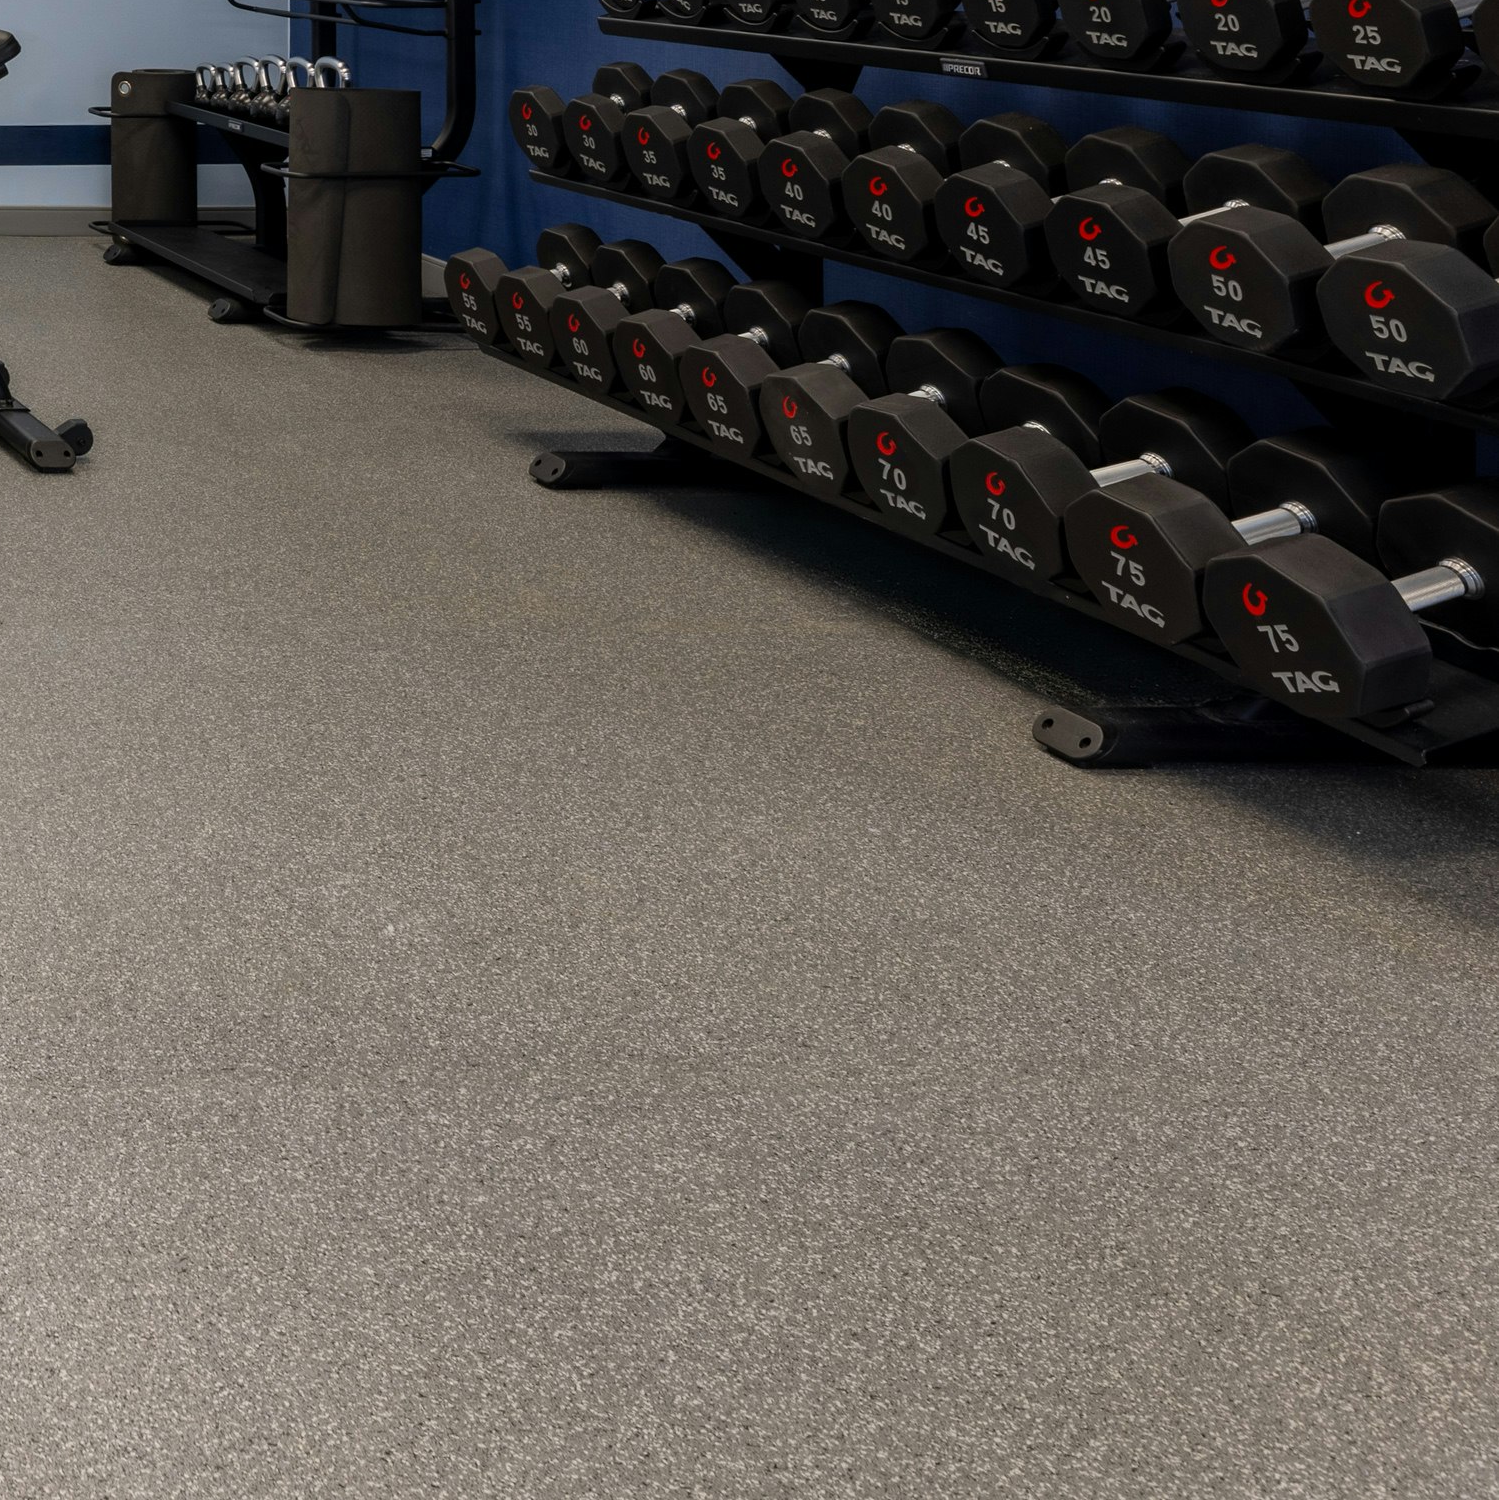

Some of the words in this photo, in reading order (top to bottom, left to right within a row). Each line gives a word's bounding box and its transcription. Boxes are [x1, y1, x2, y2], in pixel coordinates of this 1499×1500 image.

[739, 4, 762, 13] TAG
[811, 8, 837, 21] TAG
[1090, 6, 1111, 22] 20
[890, 13, 922, 26] TAG
[985, 21, 1021, 35] TAG
[1215, 14, 1239, 31] 20
[1086, 31, 1127, 47] TAG
[1353, 25, 1381, 44] 25
[1210, 41, 1257, 57] TAG
[947, 63, 982, 77] PRECOR
[1347, 55, 1401, 73] TAG
[527, 124, 537, 136] 30
[527, 145, 549, 158] TAG
[583, 135, 595, 149] 30
[580, 154, 605, 172] TAG
[643, 151, 656, 163] 35
[643, 173, 670, 187] TAG
[711, 165, 725, 180] 35
[709, 186, 738, 206] TAG
[785, 182, 803, 200] 40
[781, 205, 815, 227] TAG
[872, 201, 892, 220] 40
[866, 224, 905, 249] TAG
[967, 222, 989, 244] 45
[960, 246, 1003, 275] TAG
[1084, 247, 1110, 269] 45
[1078, 276, 1129, 302] TAG
[1212, 275, 1242, 301] 50
[463, 293, 477, 310] 55
[463, 314, 487, 334] TAG
[516, 314, 531, 331] 55
[1204, 306, 1262, 338] TAG
[1370, 315, 1407, 342] 50
[517, 338, 544, 356] TAG
[573, 338, 588, 355] 60
[573, 362, 602, 381] TAG
[639, 364, 656, 382] 60
[1366, 352, 1434, 382] TAG
[640, 391, 672, 410] TAG
[707, 393, 727, 414] 65
[708, 420, 743, 443] TAG
[790, 425, 812, 446] 65
[793, 457, 833, 479] TAG
[879, 458, 906, 490] 70
[880, 489, 926, 519] TAG
[988, 499, 1015, 530] 70
[979, 521, 1035, 570] TAG
[1111, 551, 1145, 586] 75
[1102, 576, 1165, 628] TAG
[1257, 625, 1299, 652] 75
[1272, 671, 1340, 692] TAG
